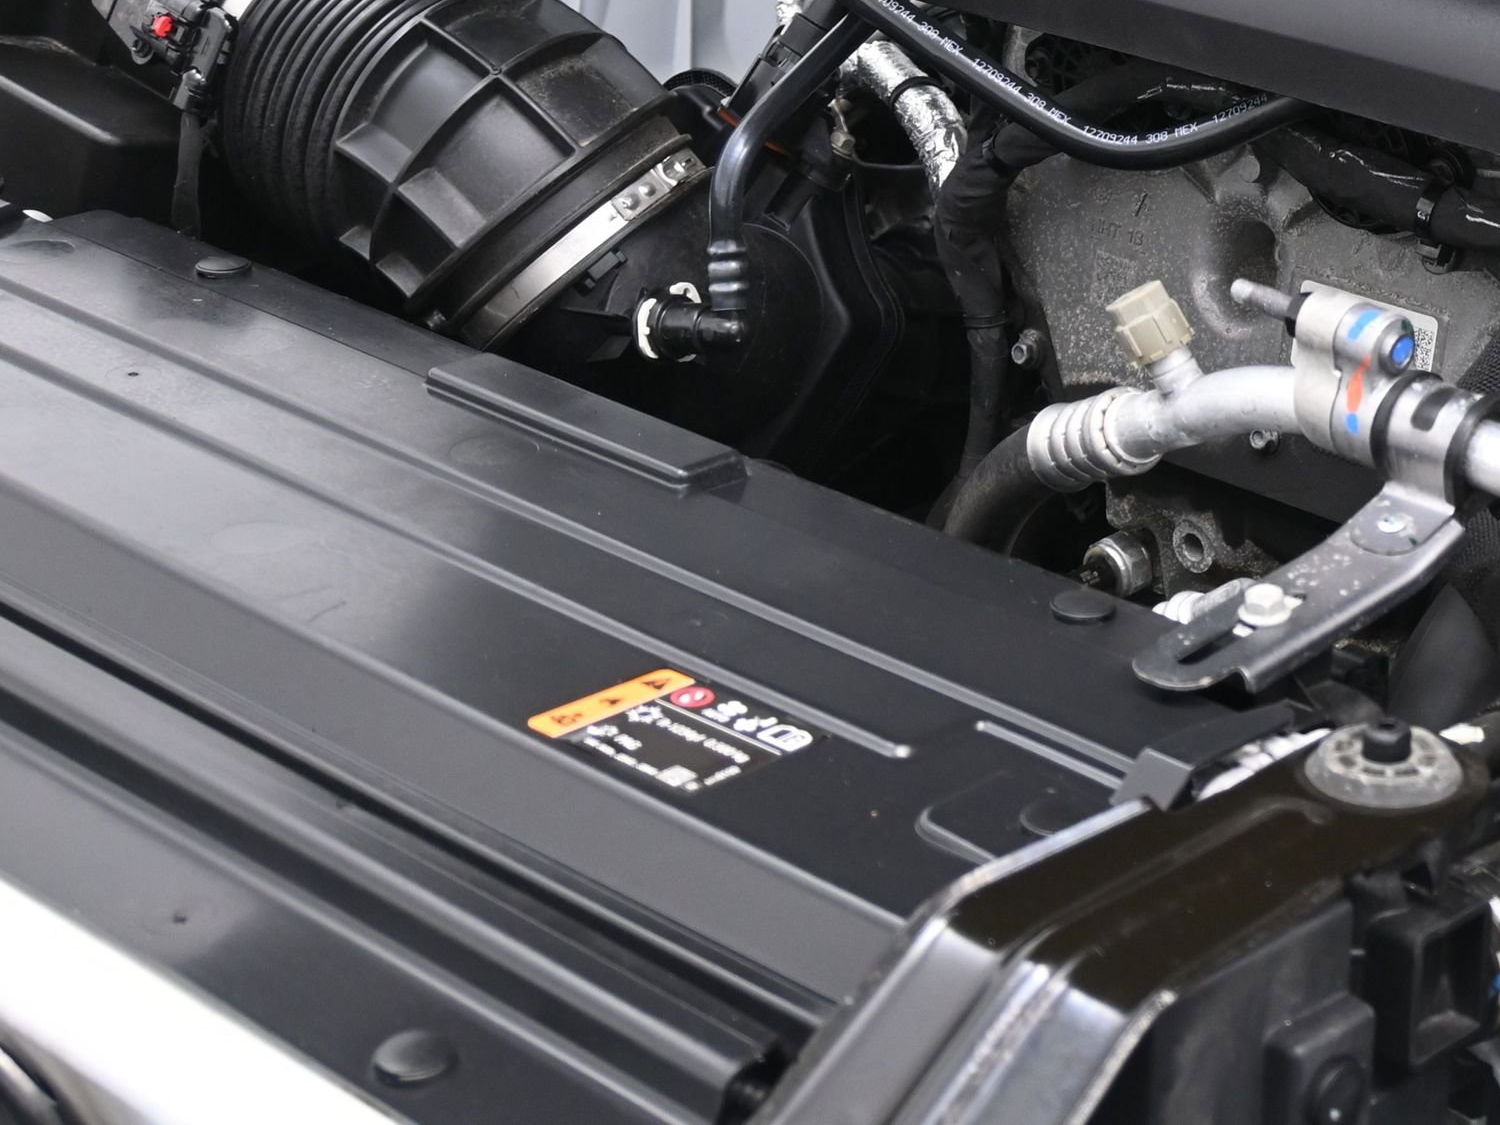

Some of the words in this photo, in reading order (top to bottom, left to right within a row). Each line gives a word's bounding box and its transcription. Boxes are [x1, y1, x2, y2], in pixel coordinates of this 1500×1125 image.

[940, 36, 963, 56] MEX
[972, 58, 1022, 94] 12709244
[1047, 107, 1071, 125] MEX
[1082, 125, 1138, 145] 12709244
[1145, 131, 1168, 144] 308
[1175, 122, 1198, 138] MEX
[1213, 93, 1268, 123] 12709244
